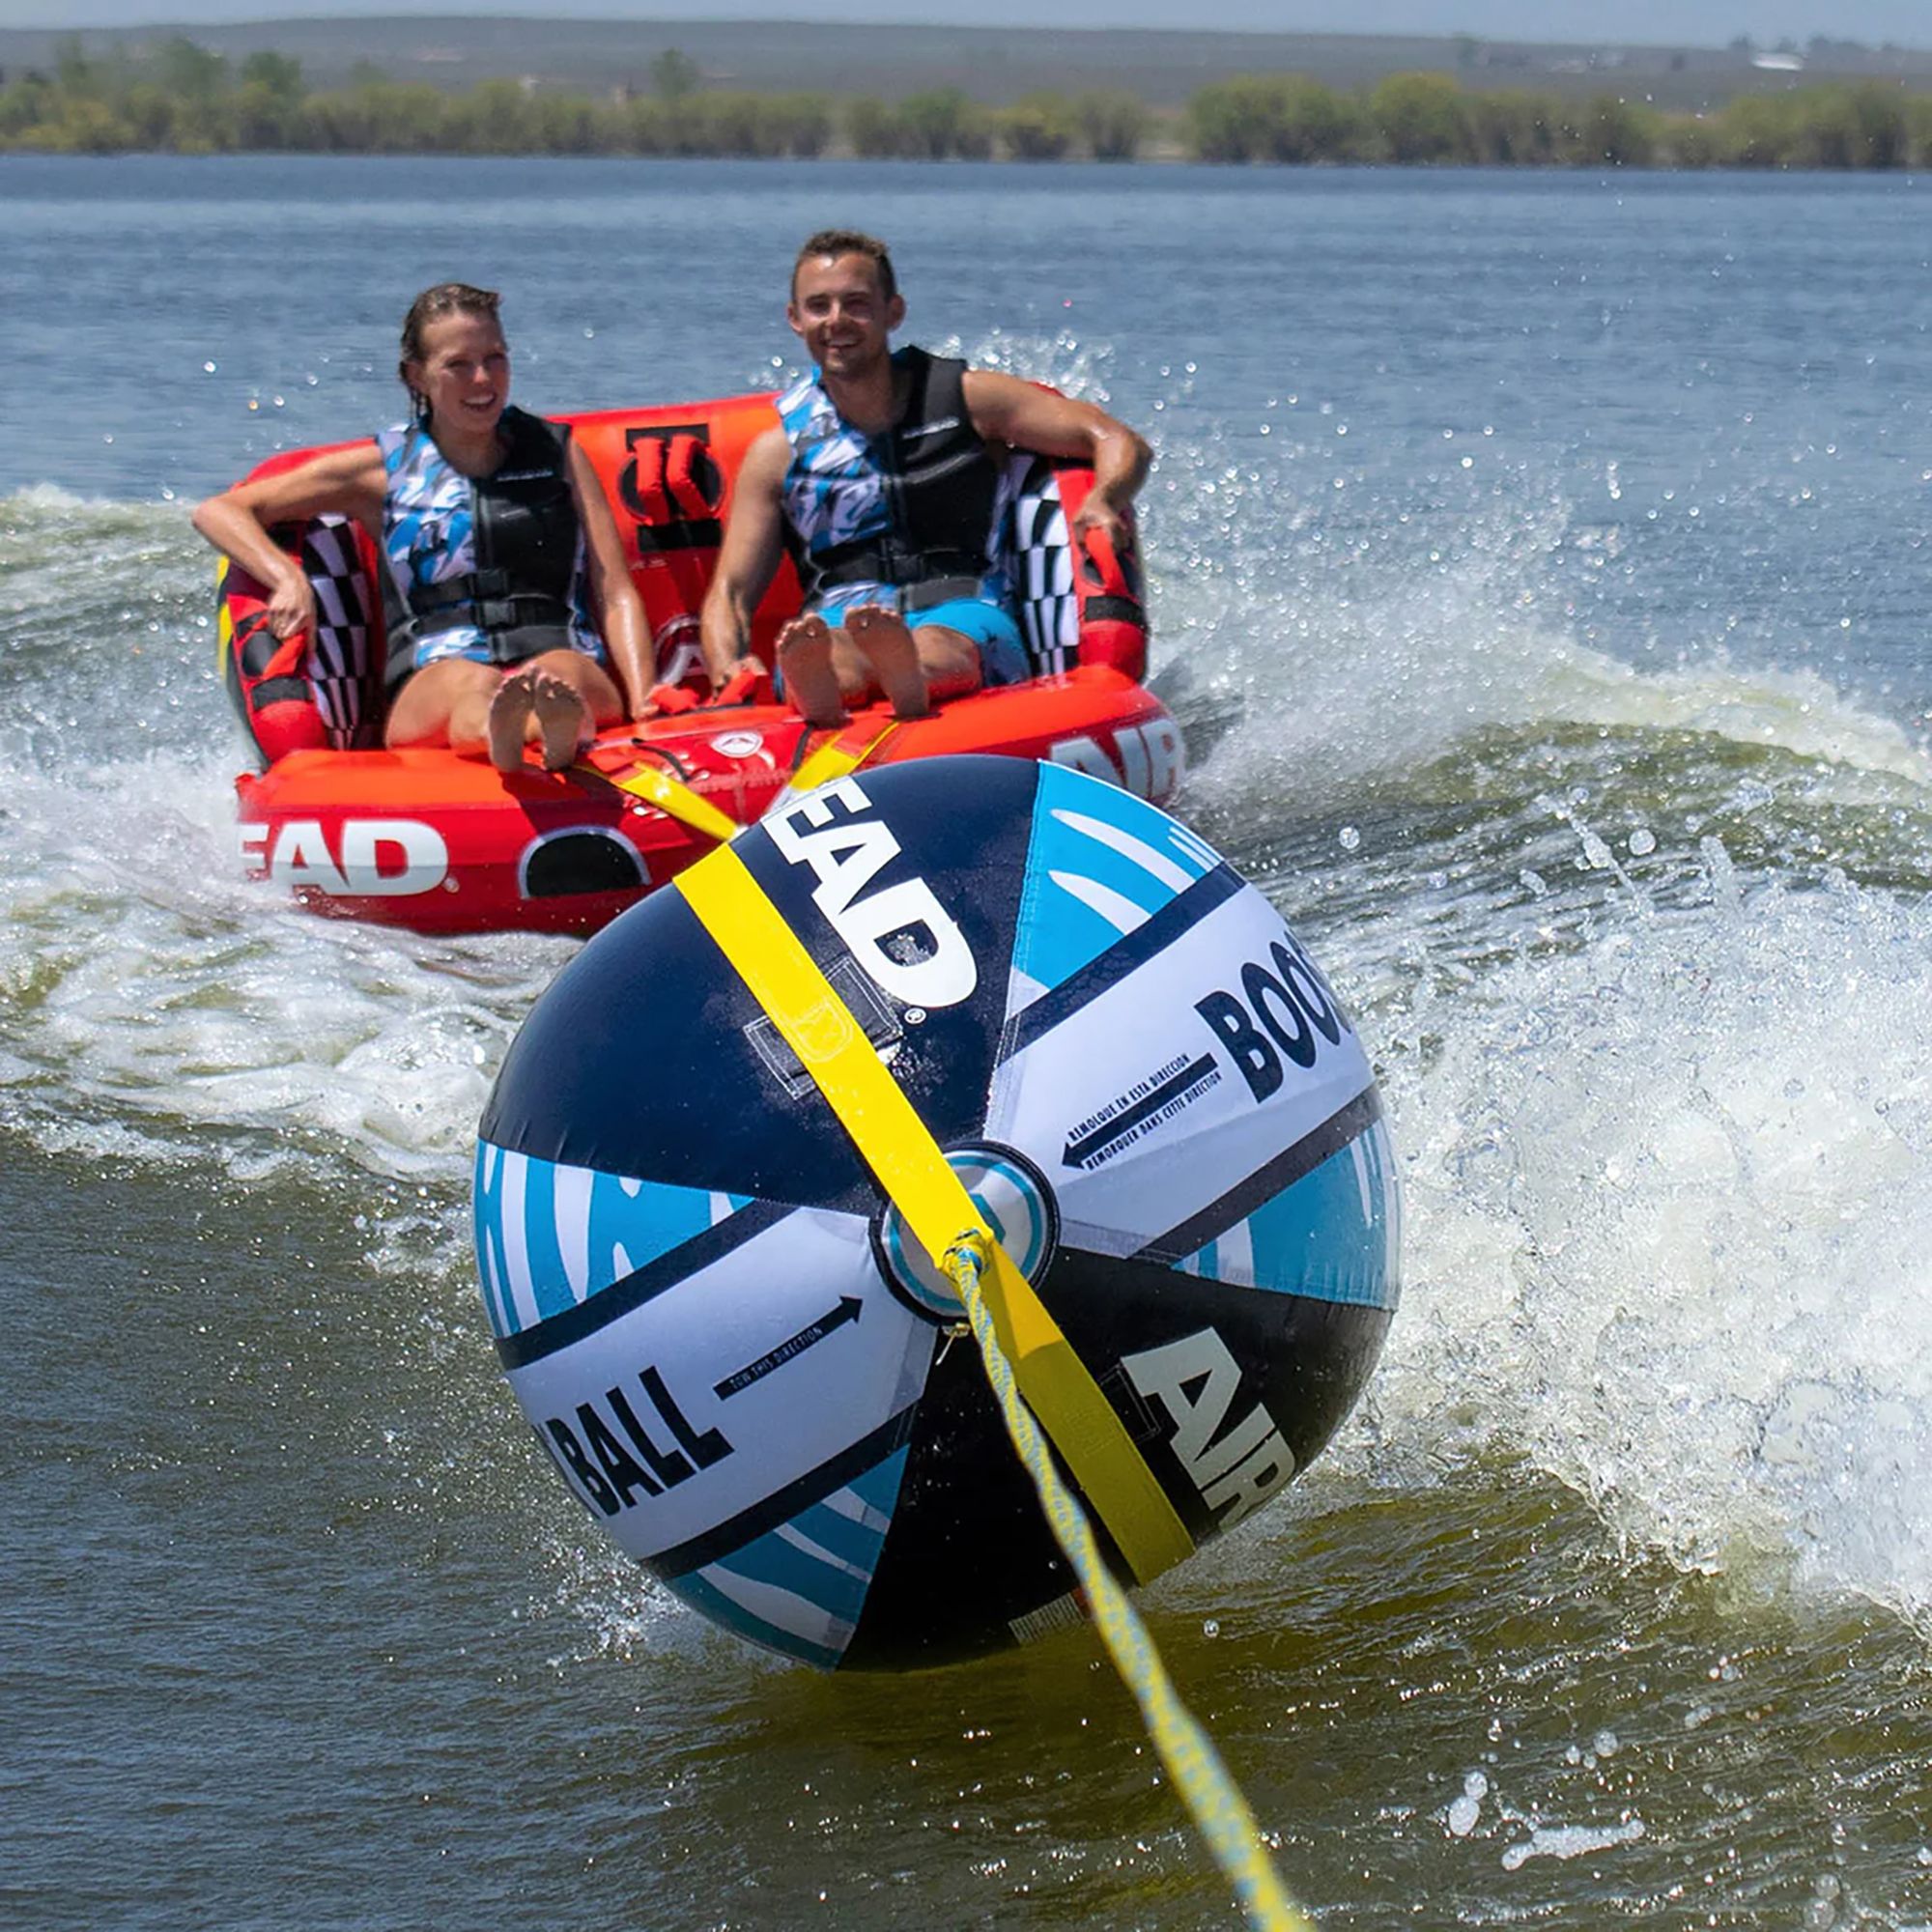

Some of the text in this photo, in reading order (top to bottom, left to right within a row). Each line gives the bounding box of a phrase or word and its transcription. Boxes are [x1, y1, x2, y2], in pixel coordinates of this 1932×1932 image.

[760, 776, 978, 1008] EAD
[1067, 1104, 1118, 1141] REMOLQUE
[1115, 1098, 1130, 1110] EN
[1128, 1081, 1151, 1101] ESTA
[1085, 1070, 1222, 1171] REMORQUER DANS CETTE DIRECTION
[729, 1325, 824, 1390] TOW THIS DIRECTION
[1120, 1326, 1296, 1533] AIR
